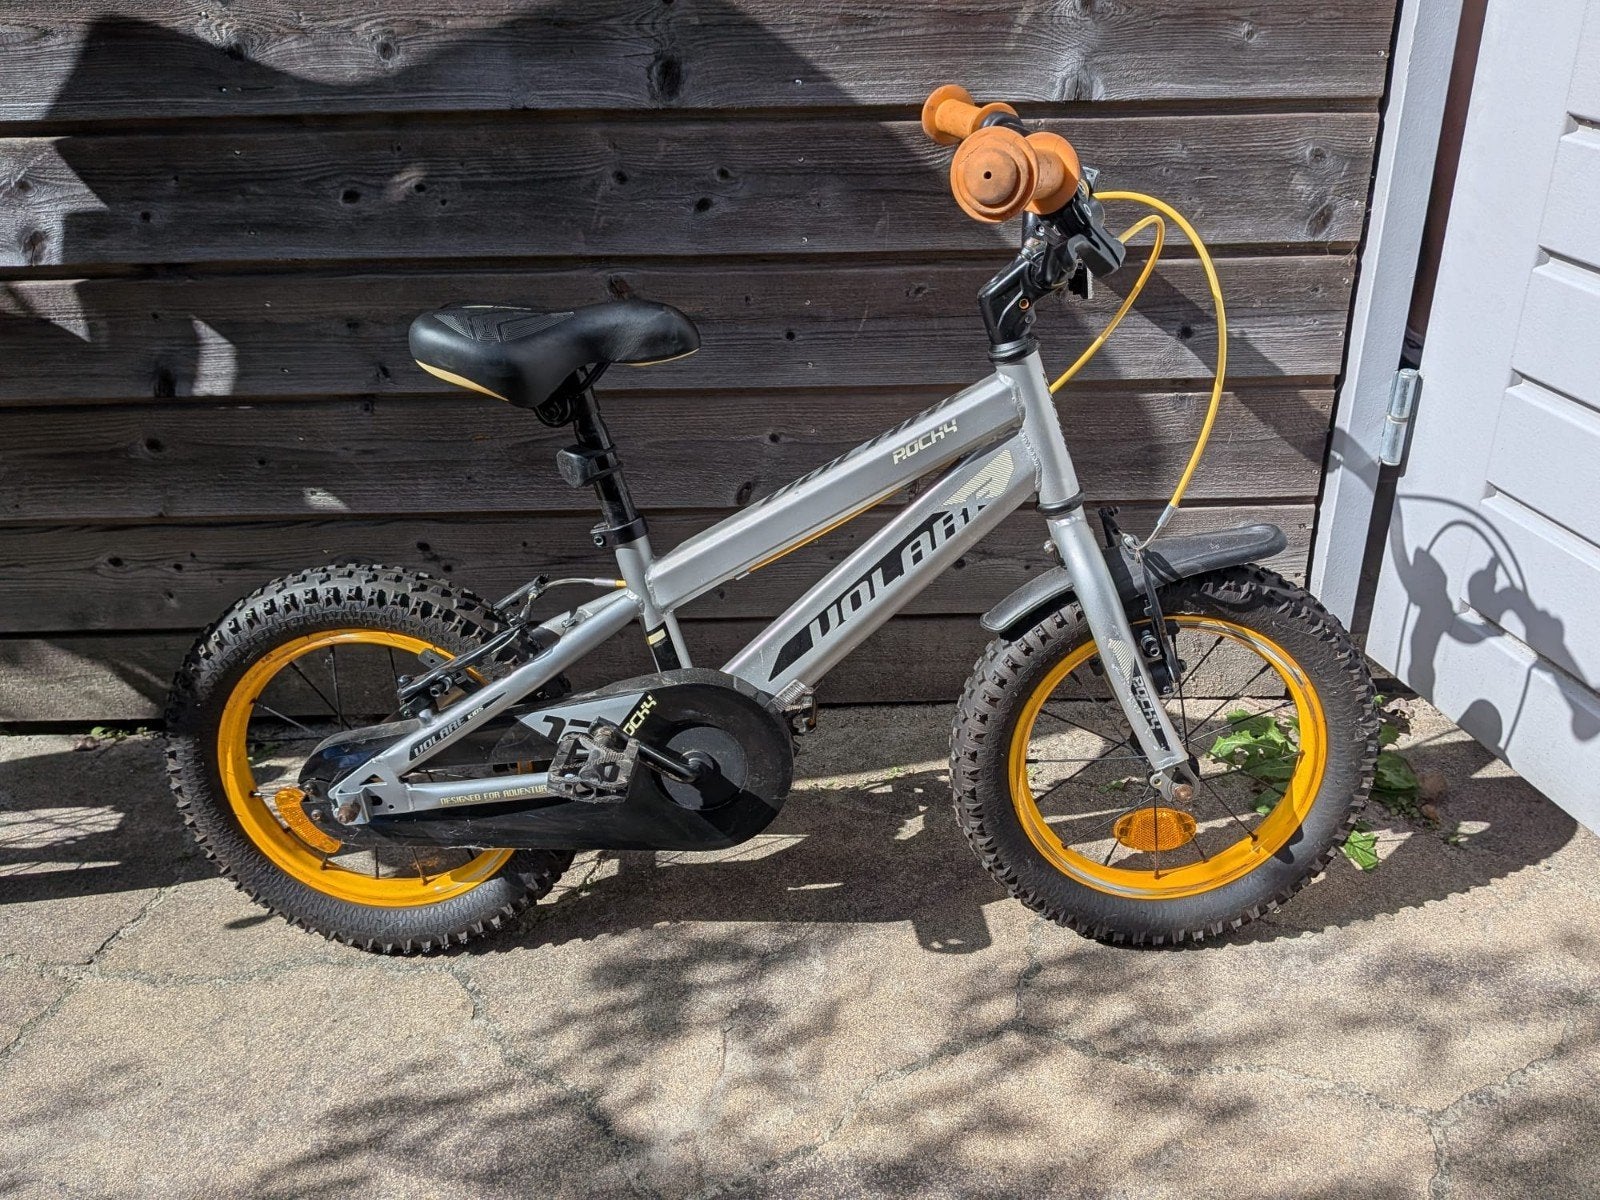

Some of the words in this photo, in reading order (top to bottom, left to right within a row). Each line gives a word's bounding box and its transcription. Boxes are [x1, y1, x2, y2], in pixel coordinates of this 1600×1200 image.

[893, 418, 957, 465] ROCKY
[808, 477, 994, 641] VOLARE
[622, 695, 657, 737] OCKY
[1132, 675, 1162, 730] ROCKY
[414, 717, 466, 757] VOLARE
[467, 705, 484, 720] KIDS
[440, 793, 481, 805] DESIGNED
[483, 790, 500, 800] FOR
[502, 784, 548, 798] ADVENTUR
